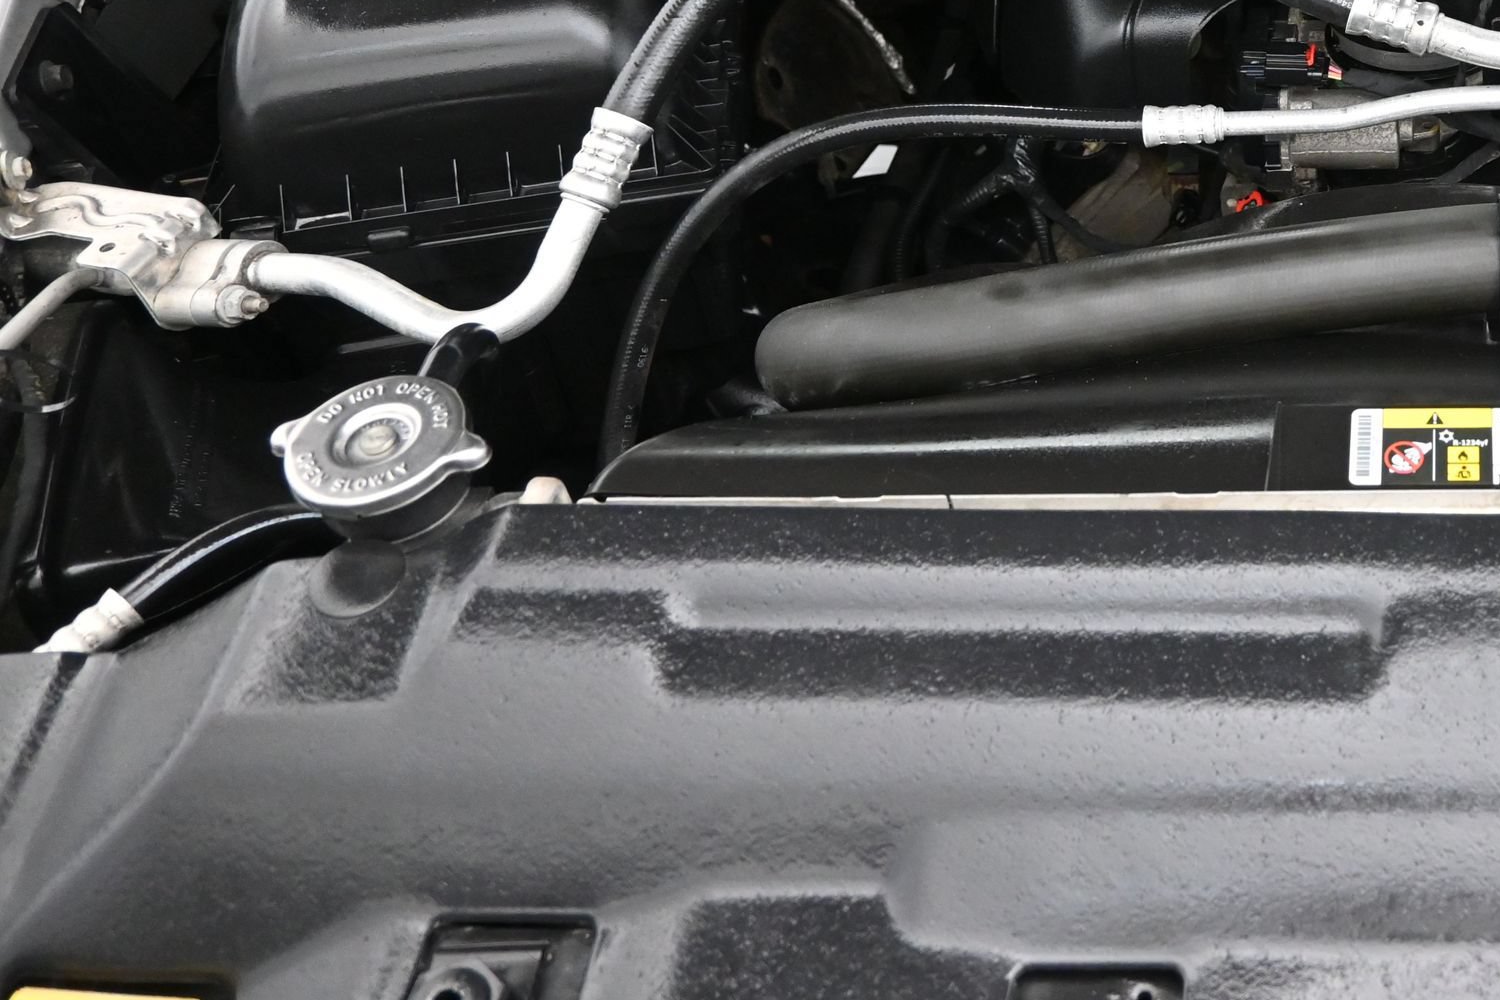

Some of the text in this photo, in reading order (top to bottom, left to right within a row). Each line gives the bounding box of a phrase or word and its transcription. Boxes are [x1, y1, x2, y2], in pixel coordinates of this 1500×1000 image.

[316, 403, 344, 425] DO
[348, 383, 385, 406] NOT
[395, 382, 439, 405] OPEN
[431, 402, 450, 429] HOT
[296, 450, 409, 493] OPEN SLOWLY
